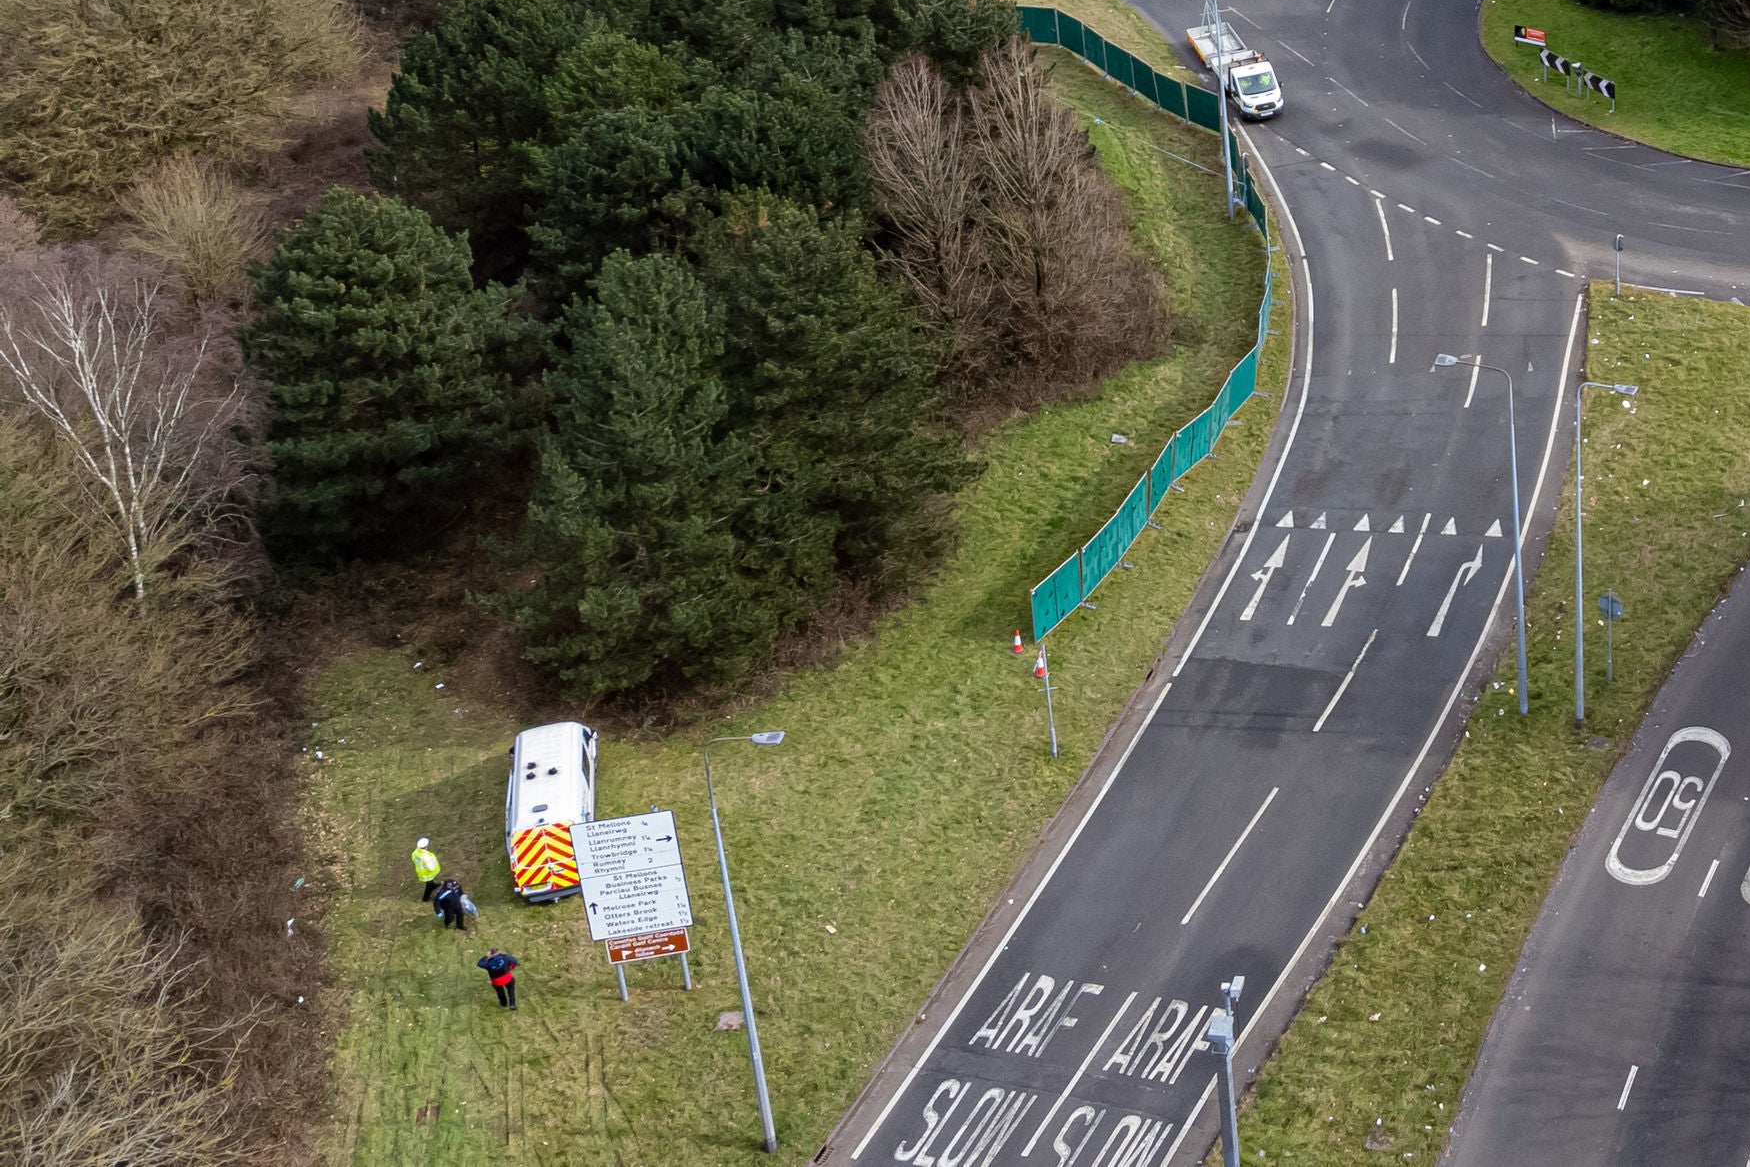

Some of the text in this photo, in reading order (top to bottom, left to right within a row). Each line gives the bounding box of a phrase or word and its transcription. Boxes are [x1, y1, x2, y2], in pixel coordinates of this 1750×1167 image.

[1635, 769, 1704, 840] 50
[598, 821, 631, 829] Mellons
[589, 835, 637, 846] Llanrumney
[592, 849, 638, 860] Trowbridge
[593, 858, 626, 867] Rumney
[595, 865, 626, 874] Rhymni
[626, 870, 658, 879] Mellons
[606, 875, 668, 889] Business Parks
[603, 903, 636, 912] Melrose
[604, 912, 631, 920] Otters
[634, 908, 658, 916] Brook
[606, 920, 635, 928] Waters
[638, 916, 658, 924] Edge
[608, 926, 643, 936] Lakeside
[646, 921, 674, 929] retreat
[969, 972, 1104, 1059] ARAF
[894, 1078, 1037, 1167] SLOW
